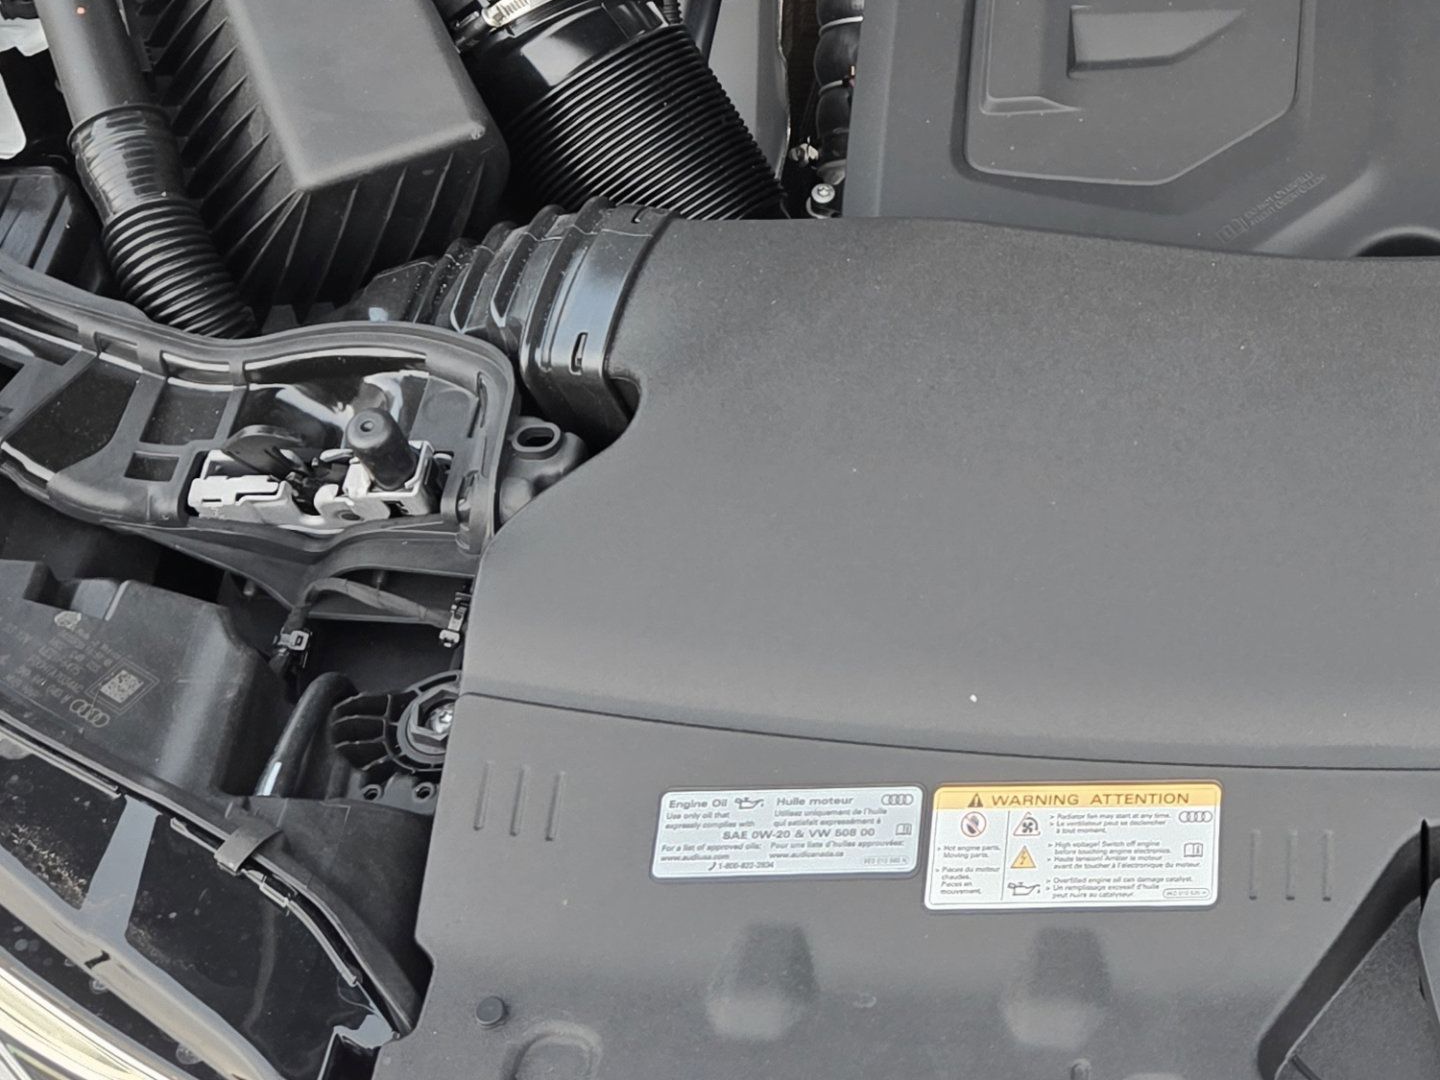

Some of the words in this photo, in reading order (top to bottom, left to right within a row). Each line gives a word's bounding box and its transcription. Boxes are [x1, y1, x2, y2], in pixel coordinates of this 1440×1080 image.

[668, 799, 708, 810] Engine
[712, 799, 728, 808] Oil
[776, 797, 806, 806] Huile
[808, 796, 854, 806] moteur
[991, 794, 1080, 807] WARNING
[1089, 793, 1190, 806] ATTENTION
[666, 812, 682, 820] Use
[683, 812, 701, 821] only
[774, 809, 803, 817] Utilisez
[803, 809, 851, 818] uniquement
[852, 808, 863, 816] de
[863, 808, 888, 816] l'huile
[665, 822, 702, 830] expressly
[702, 821, 737, 830] complies
[773, 819, 787, 828] qui
[787, 819, 819, 827] satisfait
[820, 818, 875, 827] expressément
[722, 831, 748, 840] SAE
[751, 830, 791, 840] 0W-20
[794, 829, 804, 839] &
[808, 829, 832, 838] VW
[835, 828, 857, 837] 508
[860, 828, 876, 837] 00
[661, 844, 675, 852] For
[682, 844, 696, 852] list
[706, 843, 744, 852] approved
[770, 841, 789, 850] Pour
[806, 841, 823, 849] liste
[825, 840, 856, 848] d'huiles
